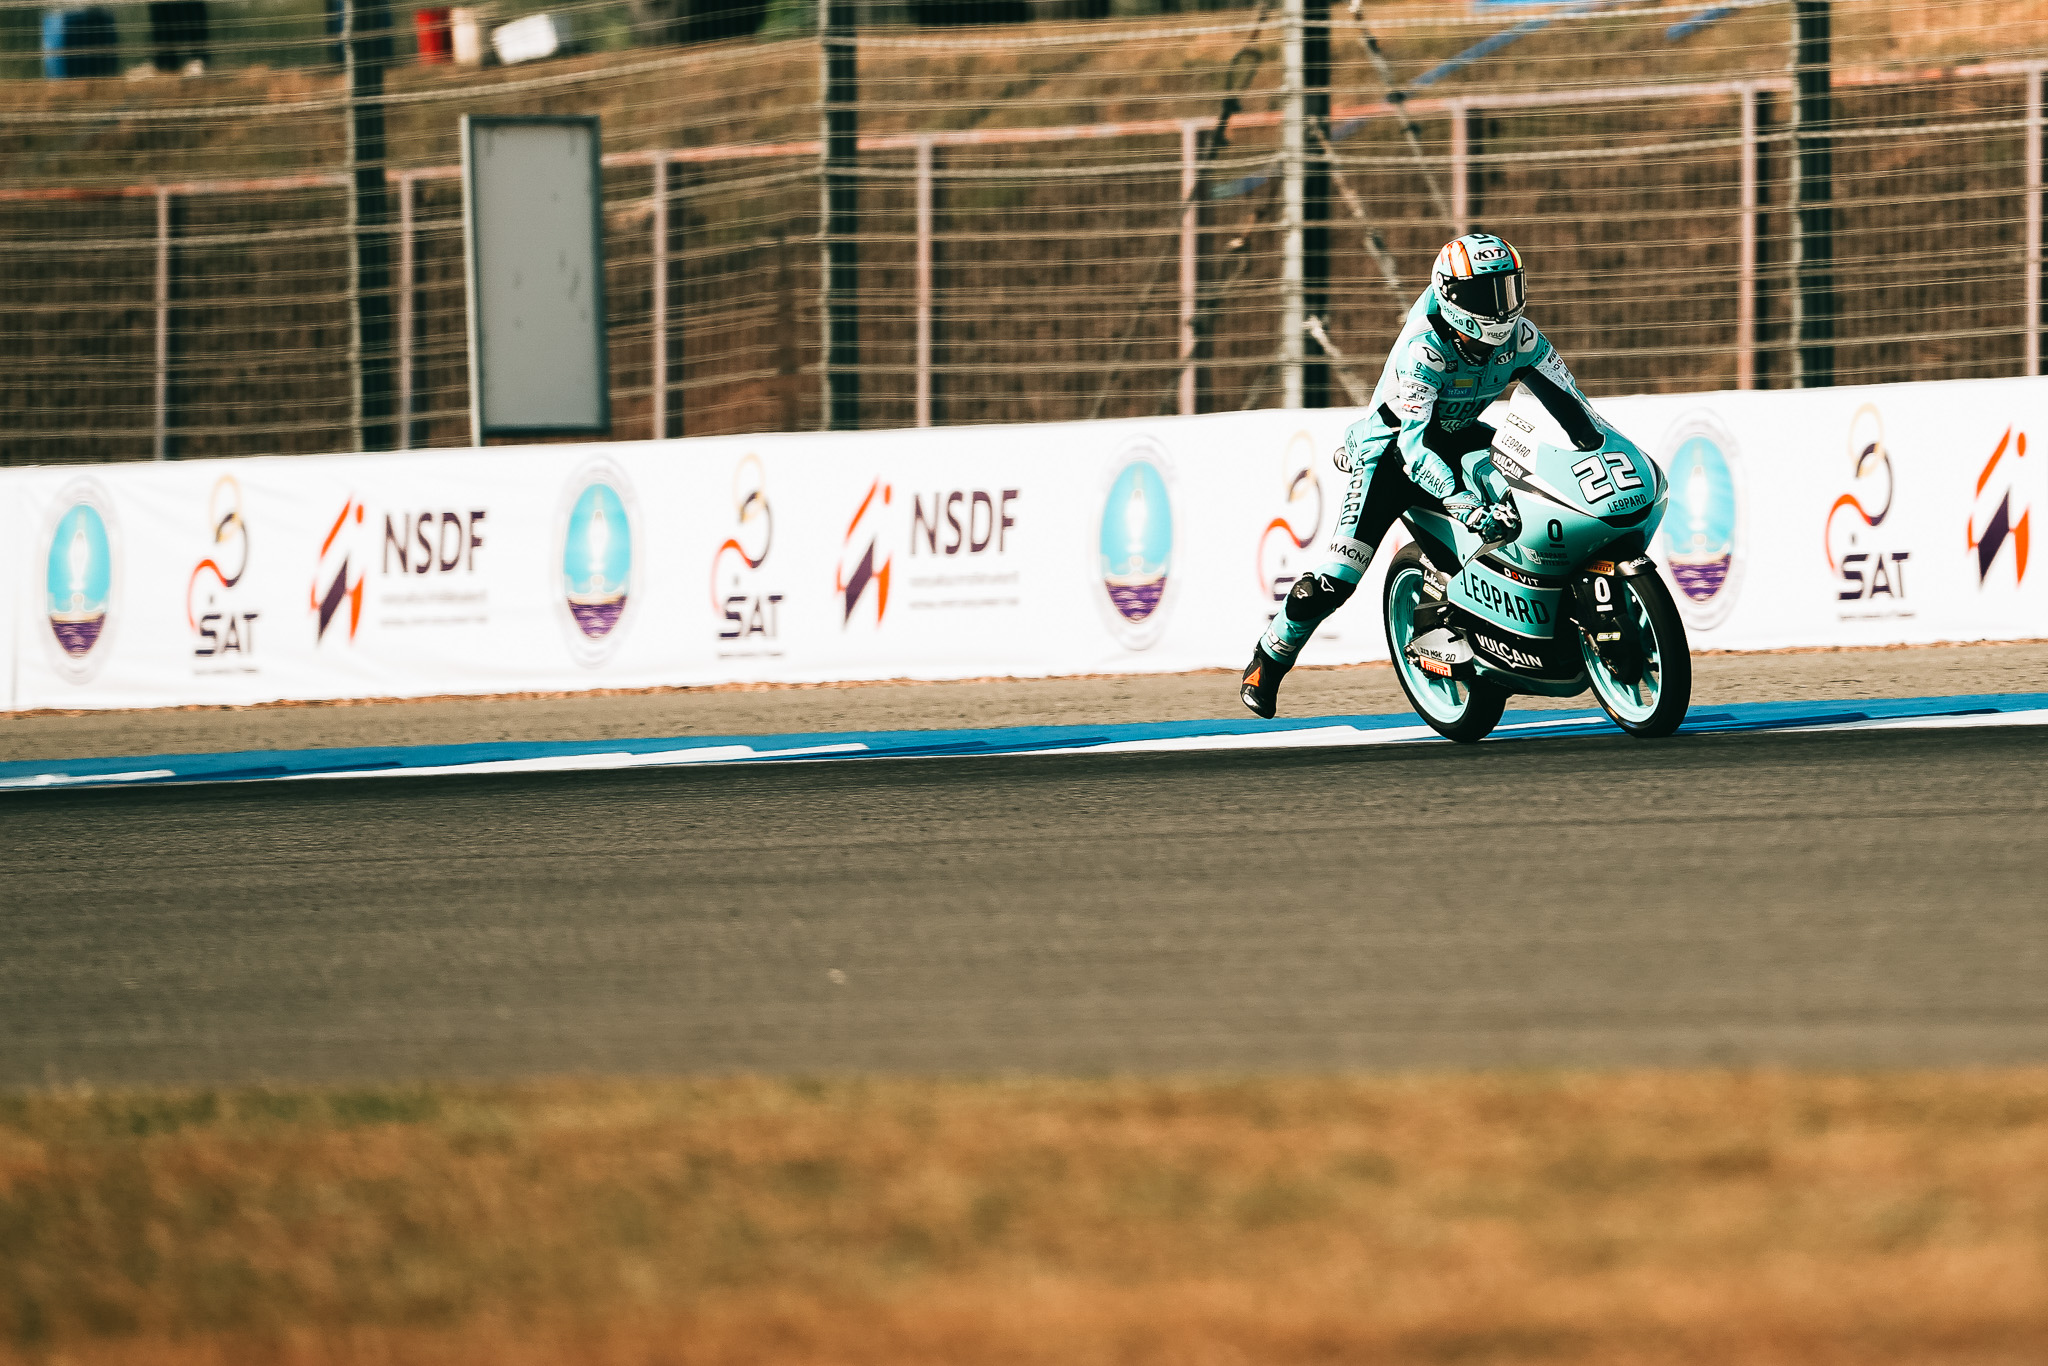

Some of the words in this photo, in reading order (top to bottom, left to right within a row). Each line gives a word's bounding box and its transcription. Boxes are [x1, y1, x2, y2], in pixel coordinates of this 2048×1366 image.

[1476, 247, 1506, 261] KYT
[1493, 452, 1523, 479] VULCAIN
[1501, 433, 1531, 458] LEOPARD
[1571, 451, 1645, 505] 22
[913, 488, 1018, 554] NSDF
[1607, 493, 1647, 513] LEOPARD
[383, 510, 486, 575] NSDF
[1330, 543, 1370, 566] MACNA
[1463, 568, 1551, 625] LEOPARD
[1838, 551, 1911, 601] SAT
[193, 612, 259, 655] SAT
[717, 594, 783, 640] SAT
[1474, 632, 1544, 668] VULCAIN
